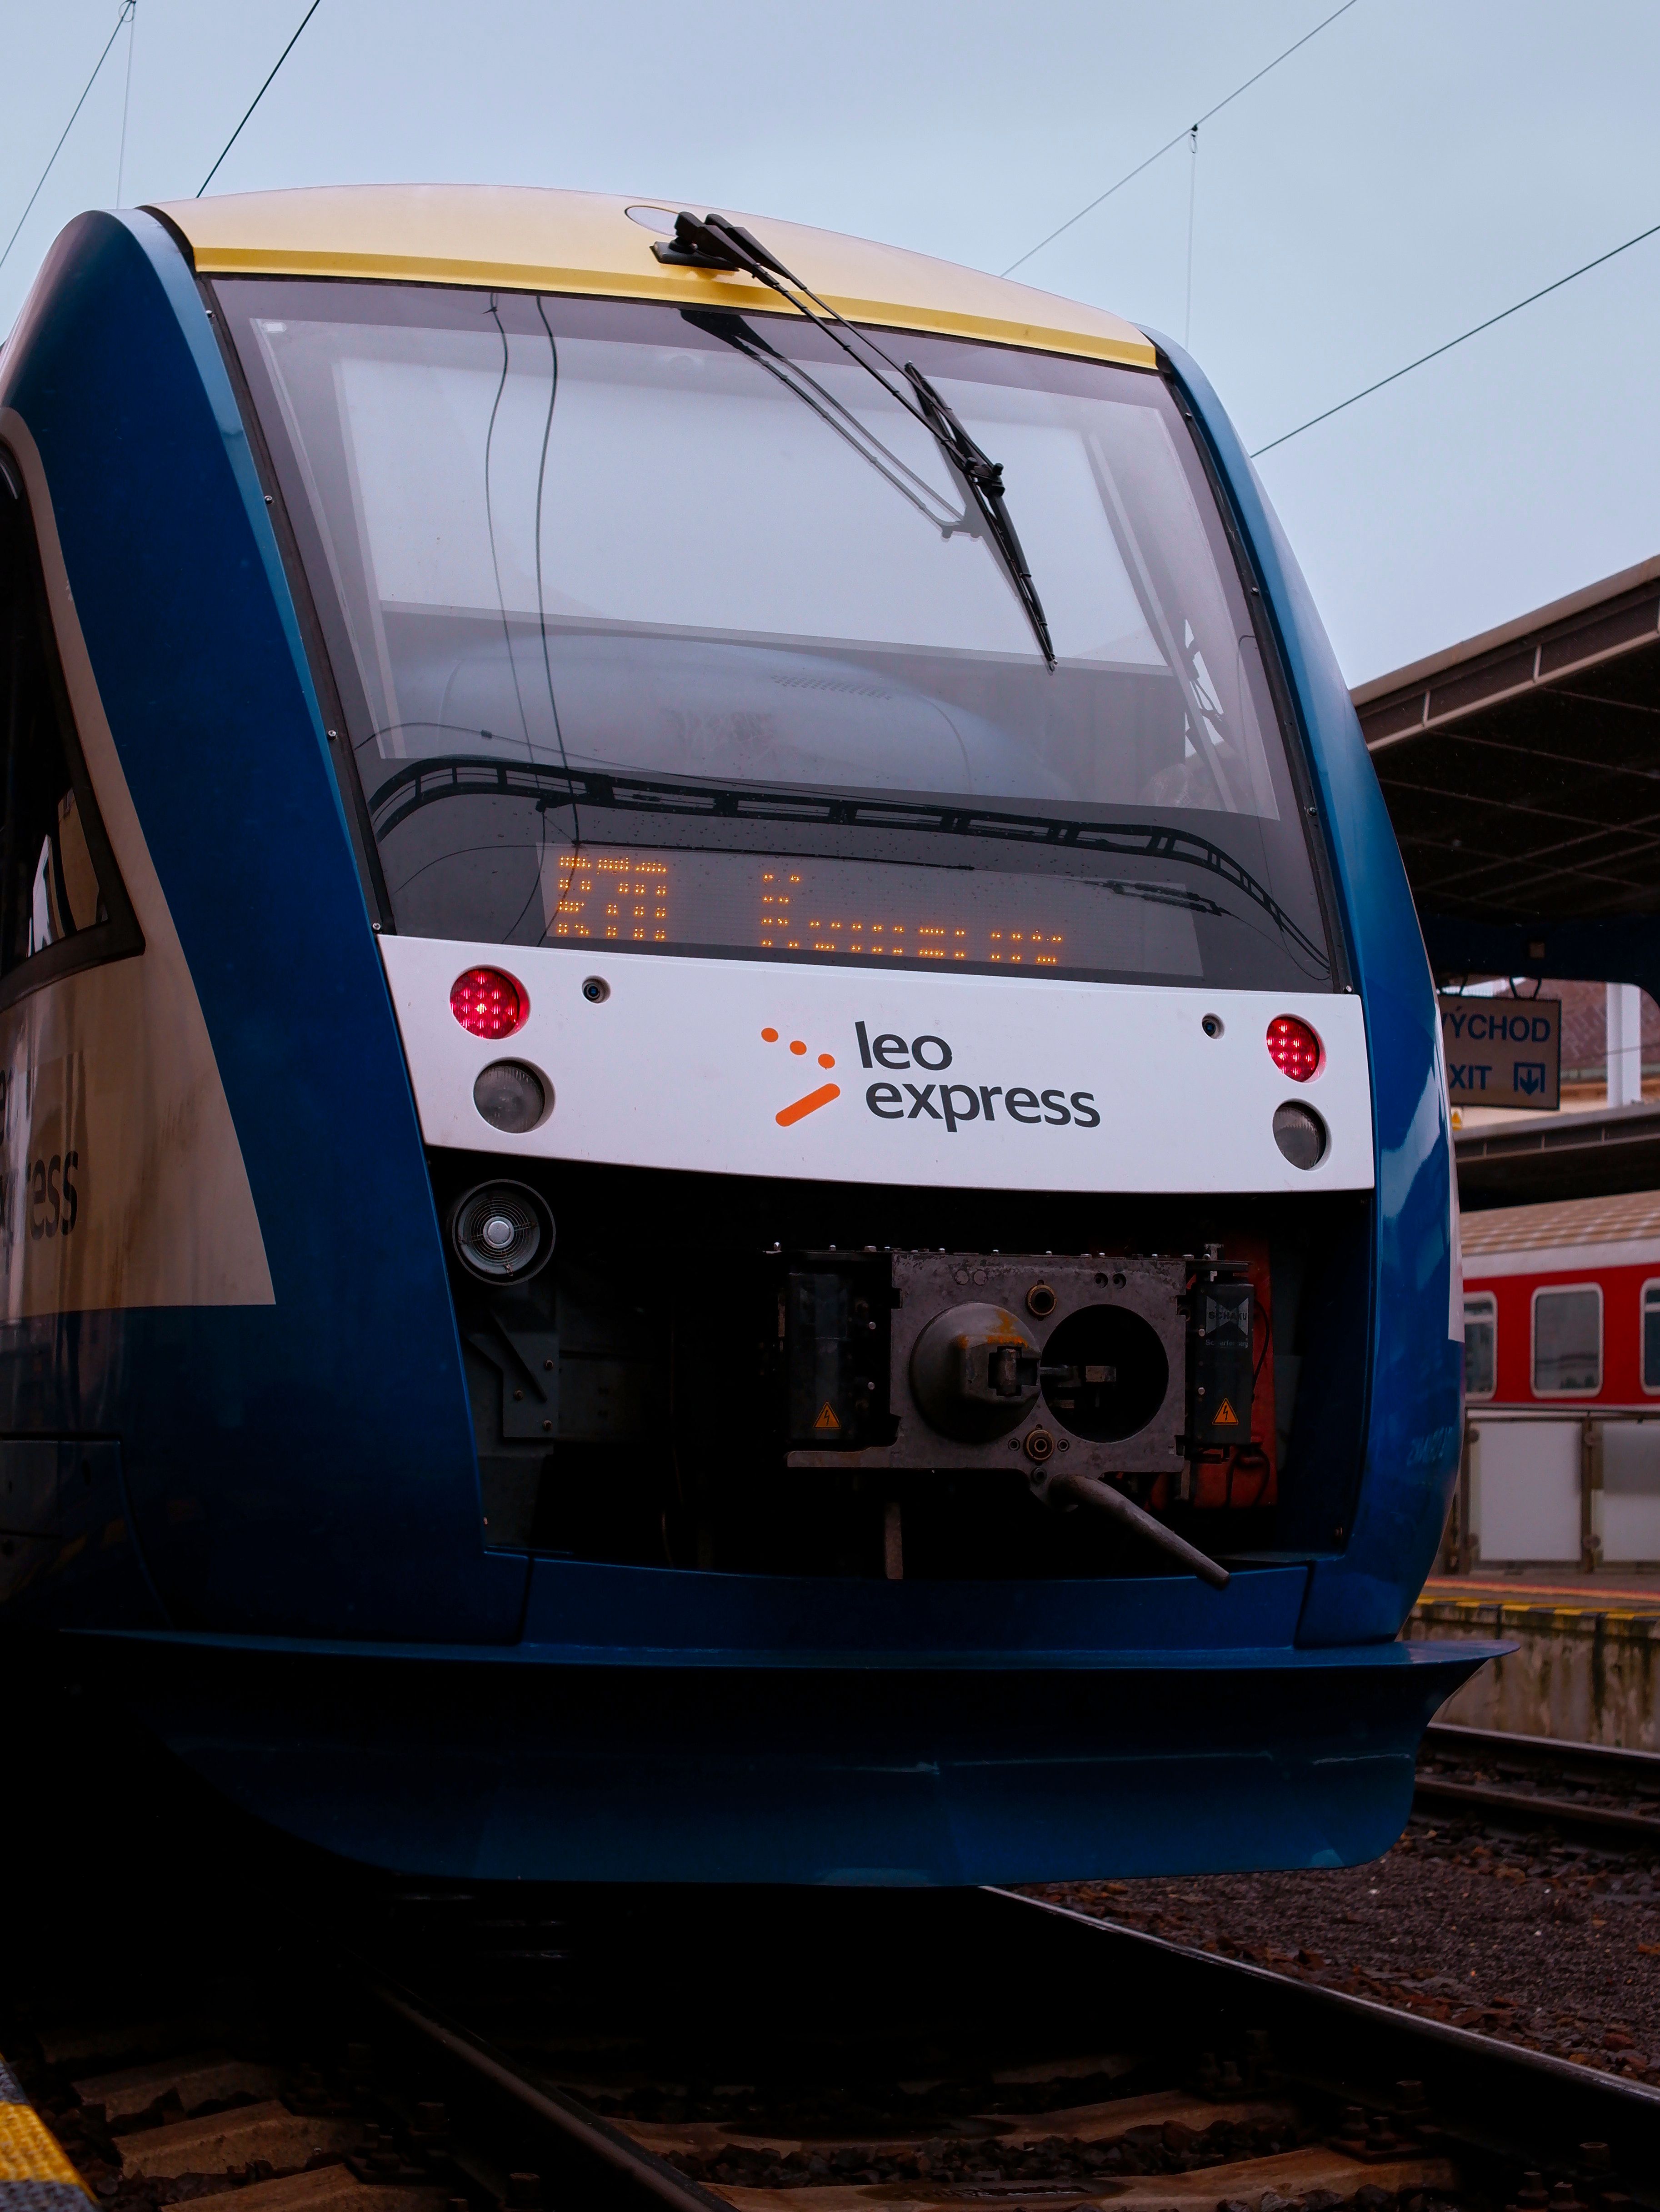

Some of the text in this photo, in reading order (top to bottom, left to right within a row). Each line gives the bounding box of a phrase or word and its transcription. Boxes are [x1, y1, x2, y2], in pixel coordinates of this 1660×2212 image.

[855, 1021, 953, 1071] leo
[1448, 1063, 1492, 1090] XIT
[865, 1082, 1101, 1133] express
